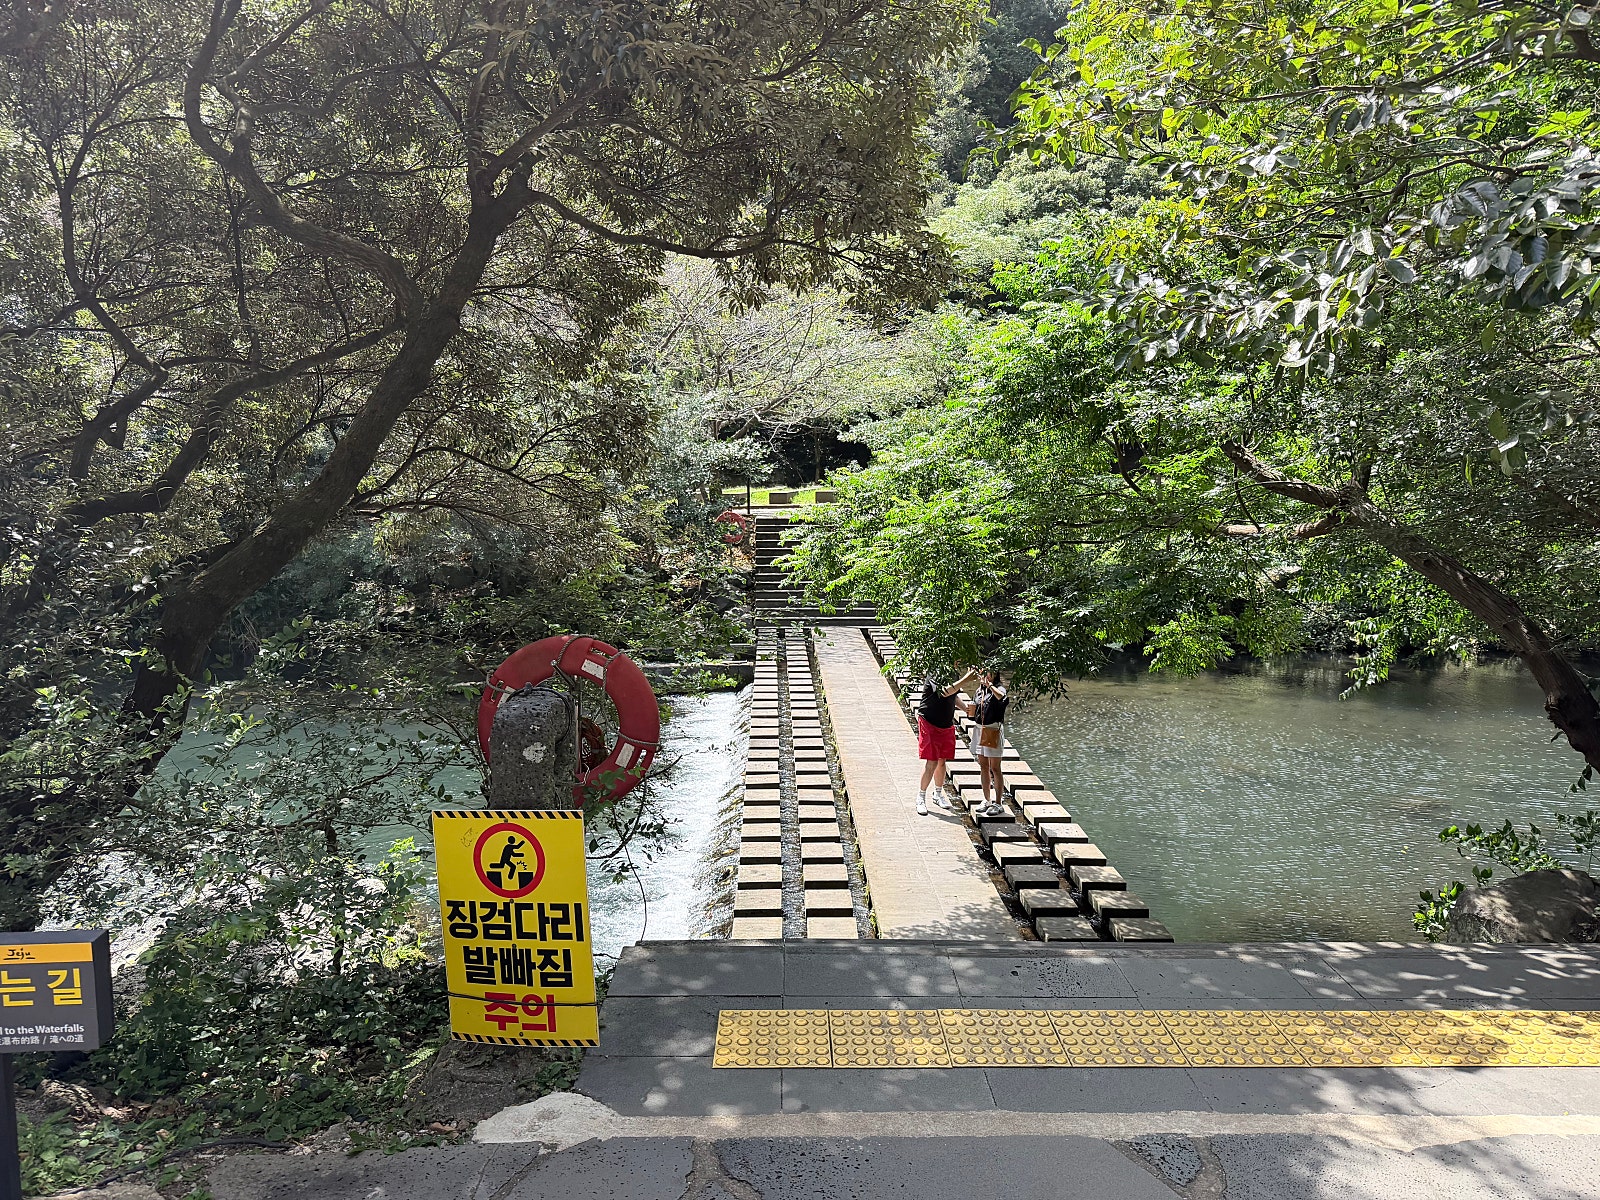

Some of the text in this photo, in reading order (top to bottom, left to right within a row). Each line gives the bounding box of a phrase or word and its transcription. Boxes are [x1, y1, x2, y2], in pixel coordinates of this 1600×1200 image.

[446, 900, 584, 942] 징검다리
[7, 948, 31, 960] Jeju
[463, 946, 573, 987] 발빠짐
[47, 968, 83, 1006] 길
[5, 1027, 16, 1035] to
[17, 1025, 34, 1035] the
[35, 1023, 85, 1034] Waterfalls
[484, 992, 556, 1032] 주의
